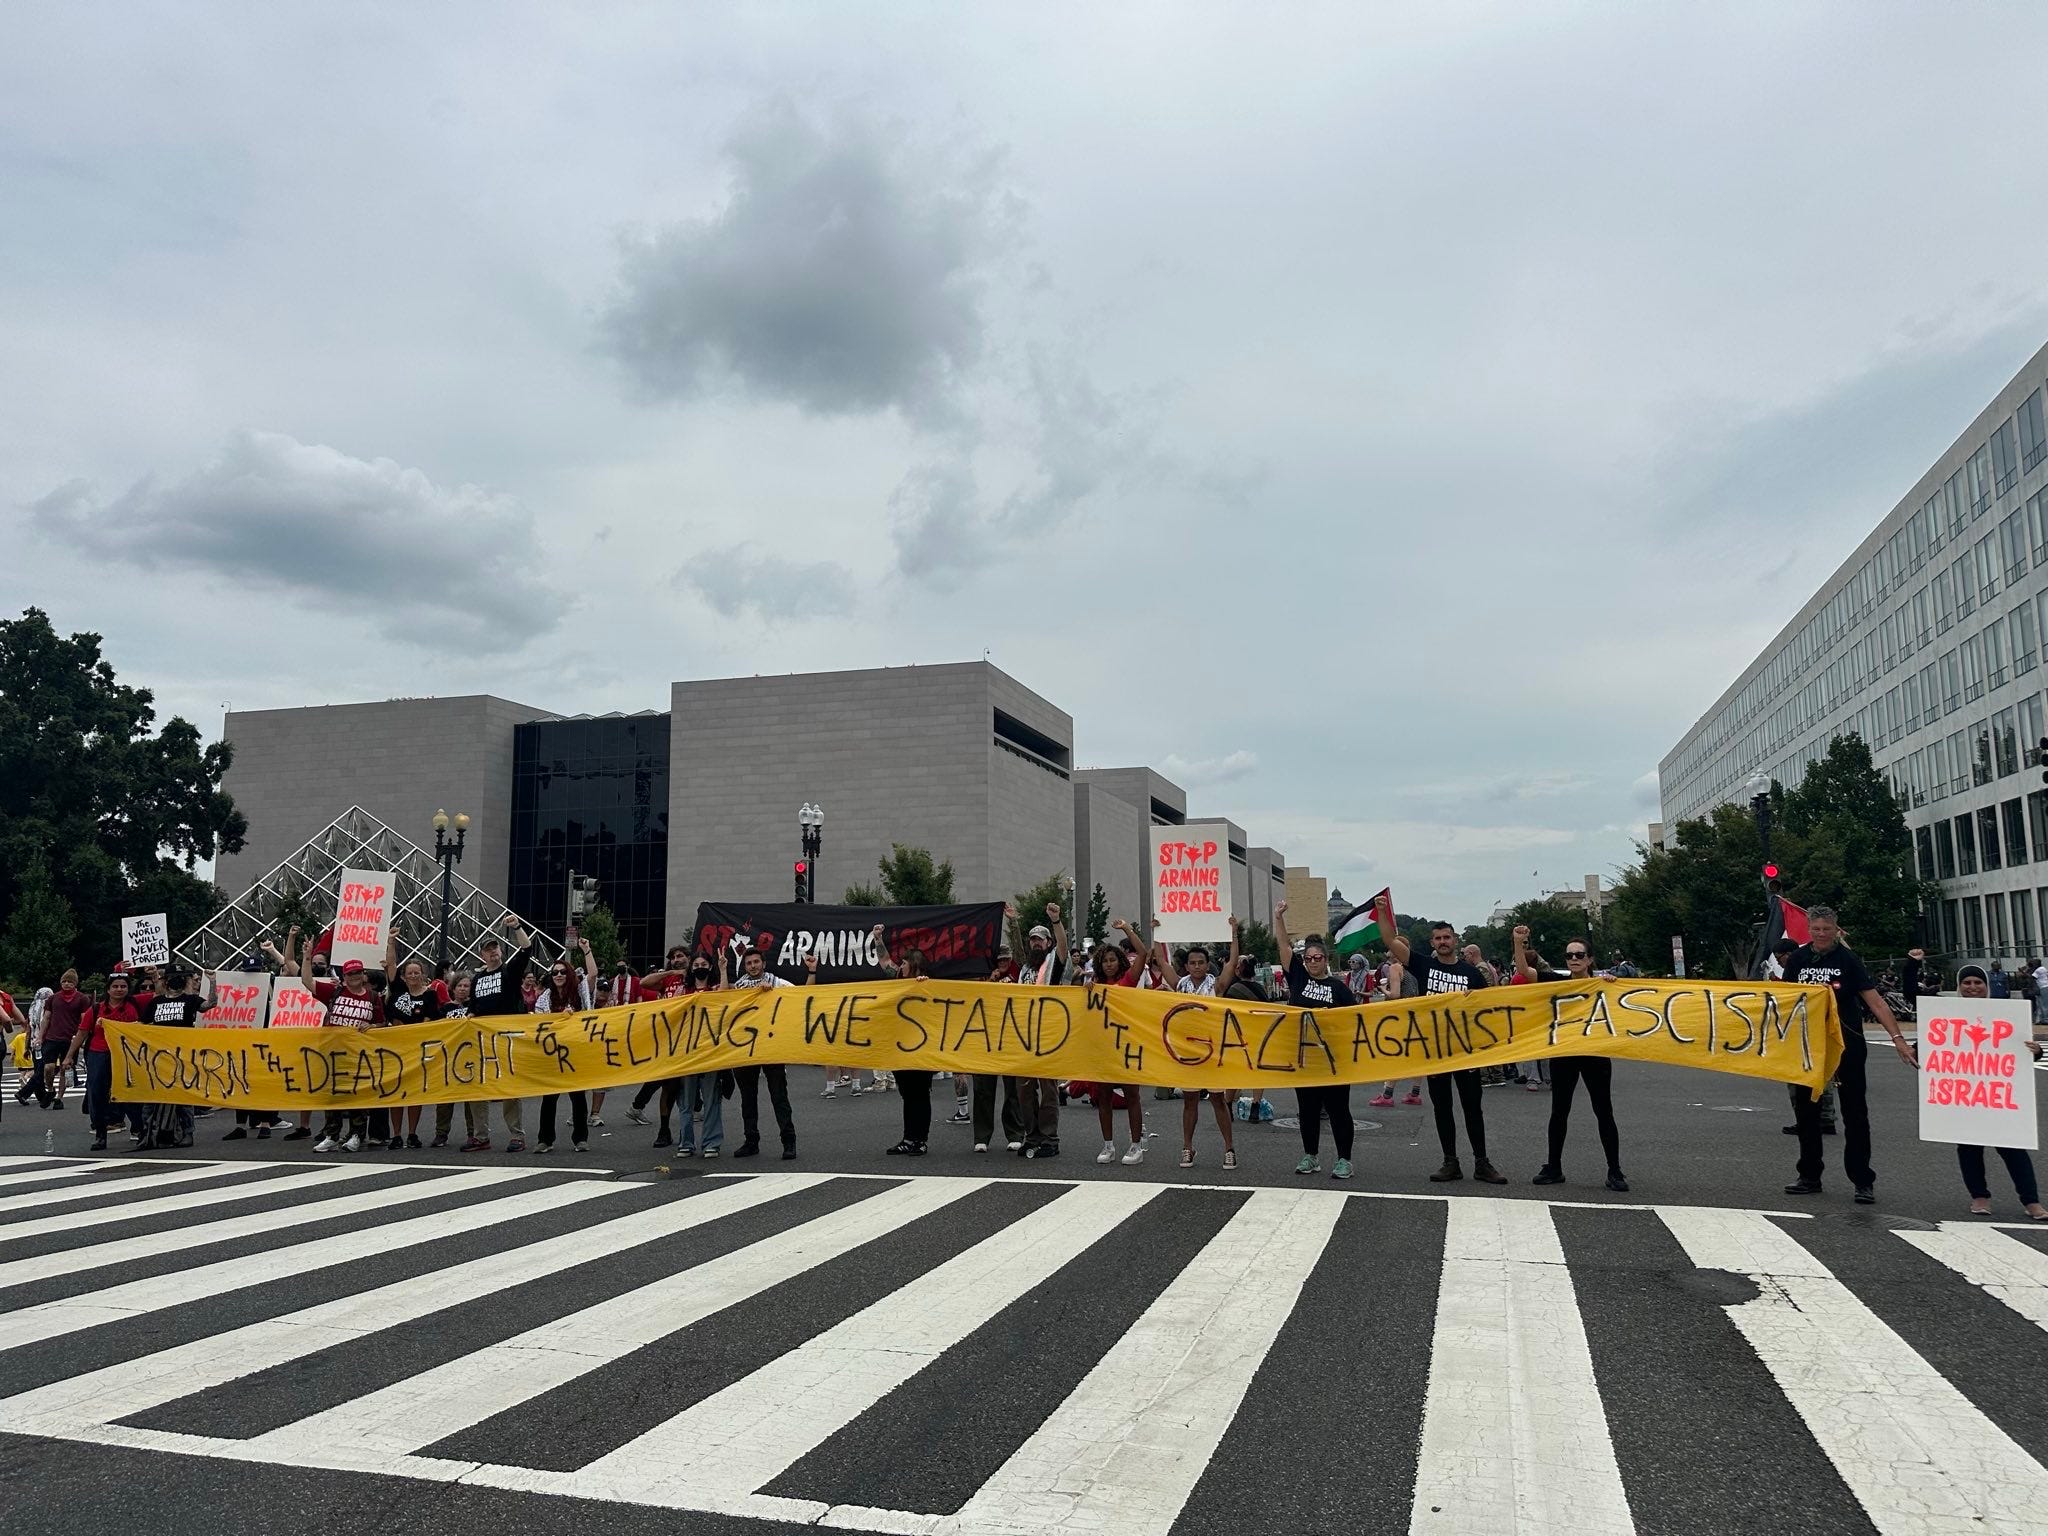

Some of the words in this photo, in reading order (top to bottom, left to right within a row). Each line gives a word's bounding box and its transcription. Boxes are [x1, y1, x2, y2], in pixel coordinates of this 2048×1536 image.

[1159, 841, 1217, 865] STOP
[1159, 867, 1219, 887] ARMING
[343, 883, 385, 904] STOP
[1161, 890, 1221, 913] ISRAEL
[340, 905, 382, 923] ARMING
[128, 926, 161, 939] WORLD
[136, 920, 151, 928] The
[337, 923, 379, 944] ISRAEL
[131, 939, 168, 956] NEVER
[135, 935, 157, 945] WILL
[777, 929, 881, 967] ARMING
[1427, 978, 1469, 993] DEMAND
[1429, 968, 1469, 985] VETERANS
[1811, 974, 1831, 982] FOR
[202, 1006, 256, 1022] ARMING
[272, 1010, 323, 1027] ARMING
[1927, 1018, 2014, 1049] STOP
[120, 1035, 251, 1100] MOURN
[252, 1042, 302, 1093] THE
[420, 1030, 525, 1093] FIGHT
[534, 1021, 576, 1074] FOR
[581, 1015, 622, 1067] THE
[625, 996, 783, 1067] LIVING!
[804, 994, 880, 1048] WE
[896, 995, 1072, 1057] STAND
[1086, 988, 1144, 1071] WITH
[1162, 1001, 1338, 1076] GAZA
[1352, 1004, 1526, 1063] AGAINST
[1547, 987, 1814, 1073] FASCISM
[1925, 1049, 2016, 1078] ARMING
[1927, 1077, 2019, 1110] ISRAEL
